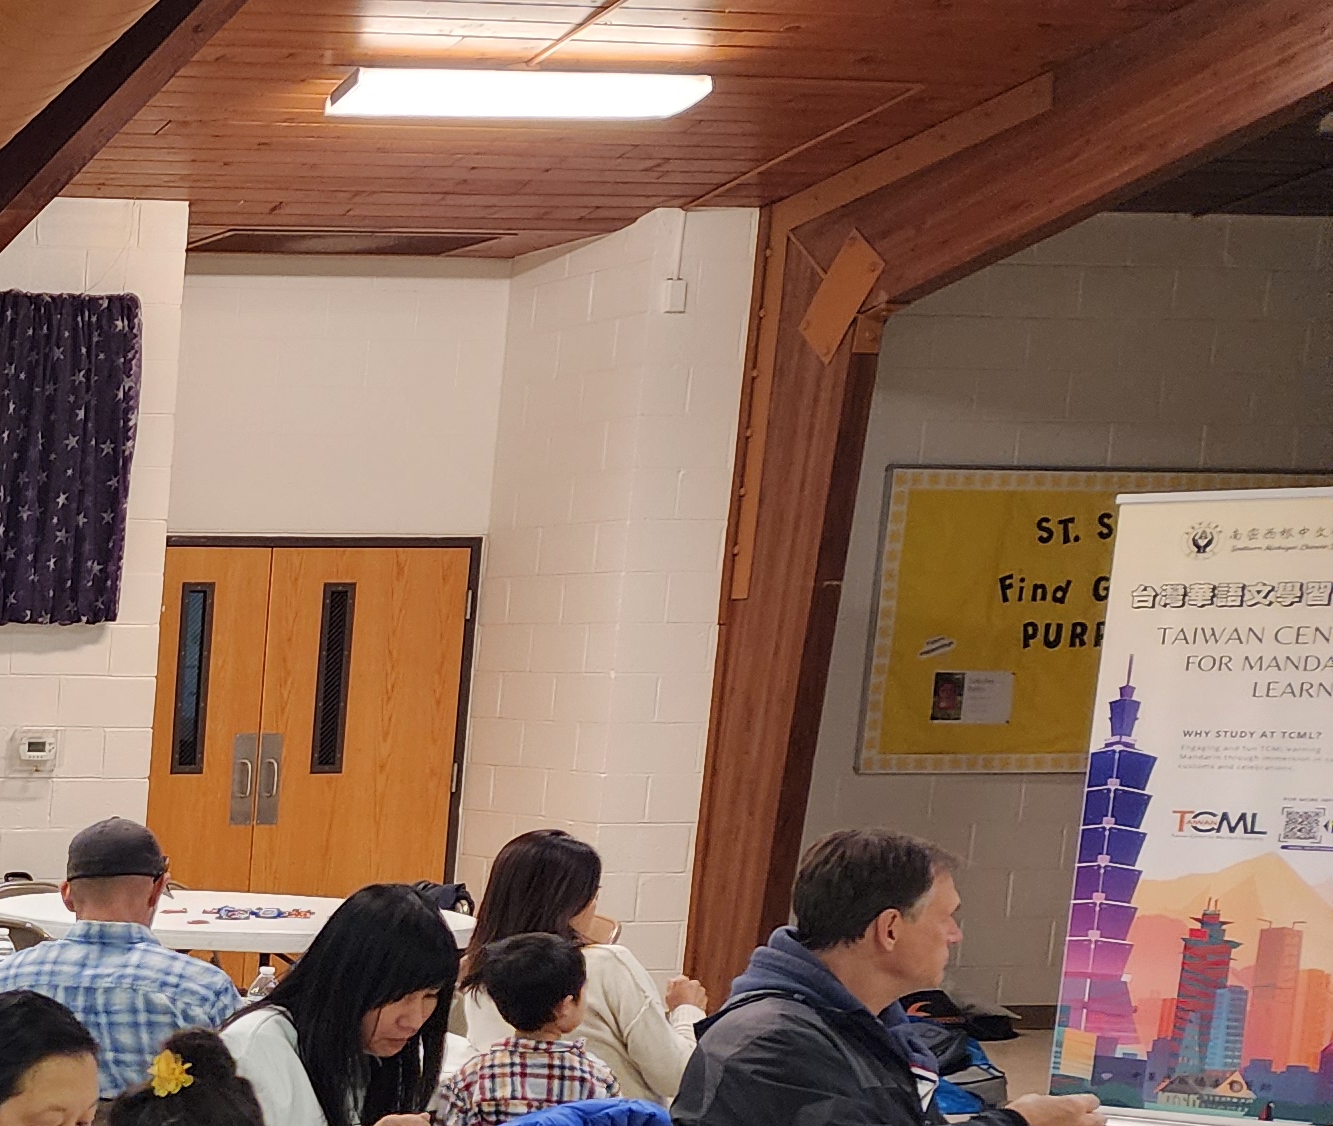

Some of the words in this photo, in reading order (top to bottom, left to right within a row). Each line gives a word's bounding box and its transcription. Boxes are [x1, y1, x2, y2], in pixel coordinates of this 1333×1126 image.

[1036, 516, 1081, 544] ST.
[998, 573, 1072, 604] Find
[1157, 626, 1265, 645] TAIWAN
[1274, 625, 1333, 645] CEN
[1185, 654, 1233, 672] FOR
[1252, 681, 1333, 699] LEARN
[1183, 730, 1211, 738] WHY
[1215, 730, 1256, 739] STUDY
[1259, 730, 1276, 739] AT
[1281, 731, 1322, 740] TCML?
[1172, 810, 1267, 835] TCML
